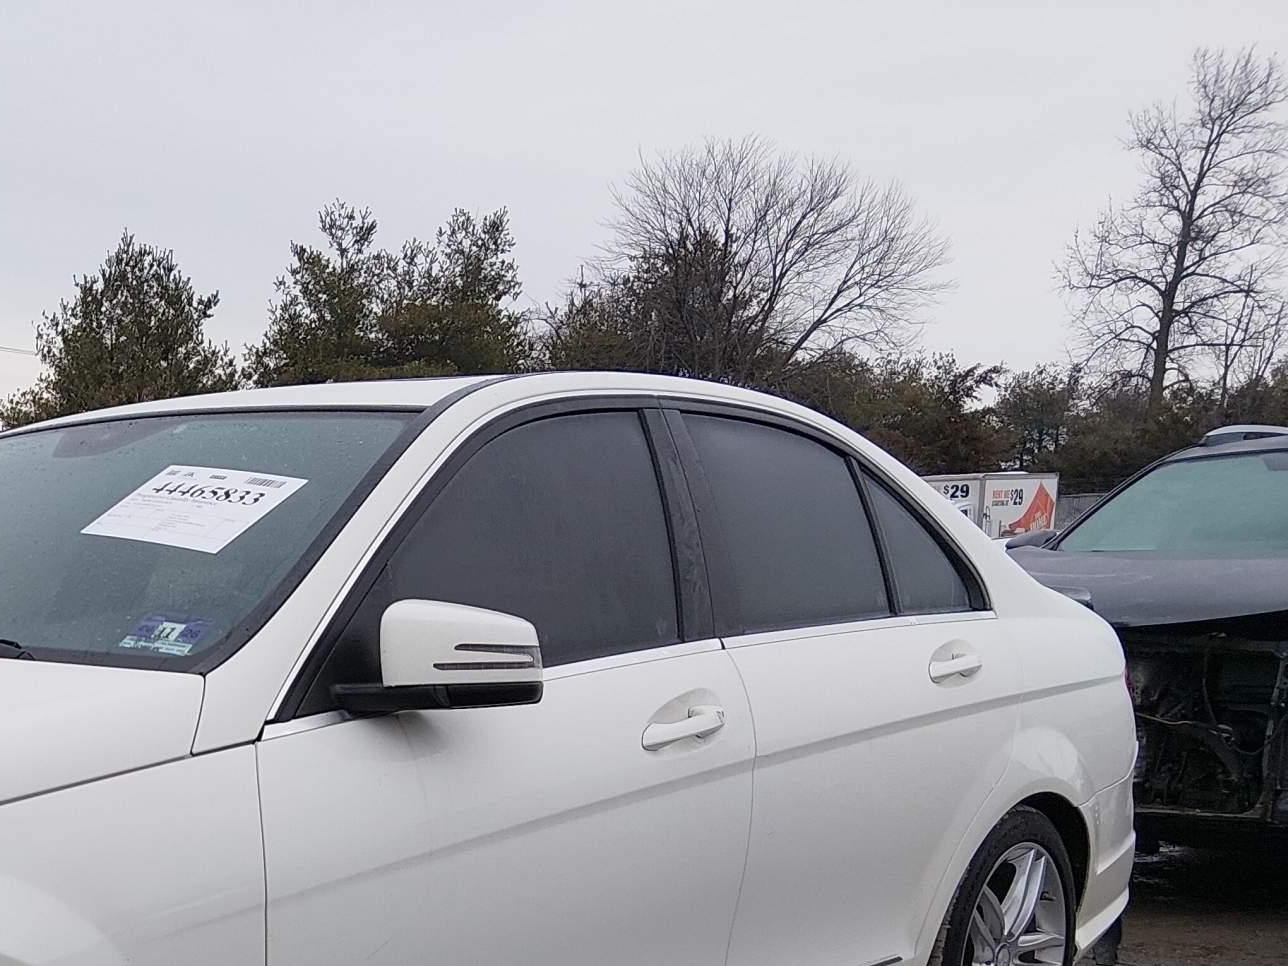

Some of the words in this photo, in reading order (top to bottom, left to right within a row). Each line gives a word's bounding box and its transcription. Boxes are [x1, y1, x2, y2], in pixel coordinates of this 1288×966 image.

[151, 481, 266, 505] 44465833
[943, 483, 970, 499] $29
[1010, 488, 1024, 506] $29
